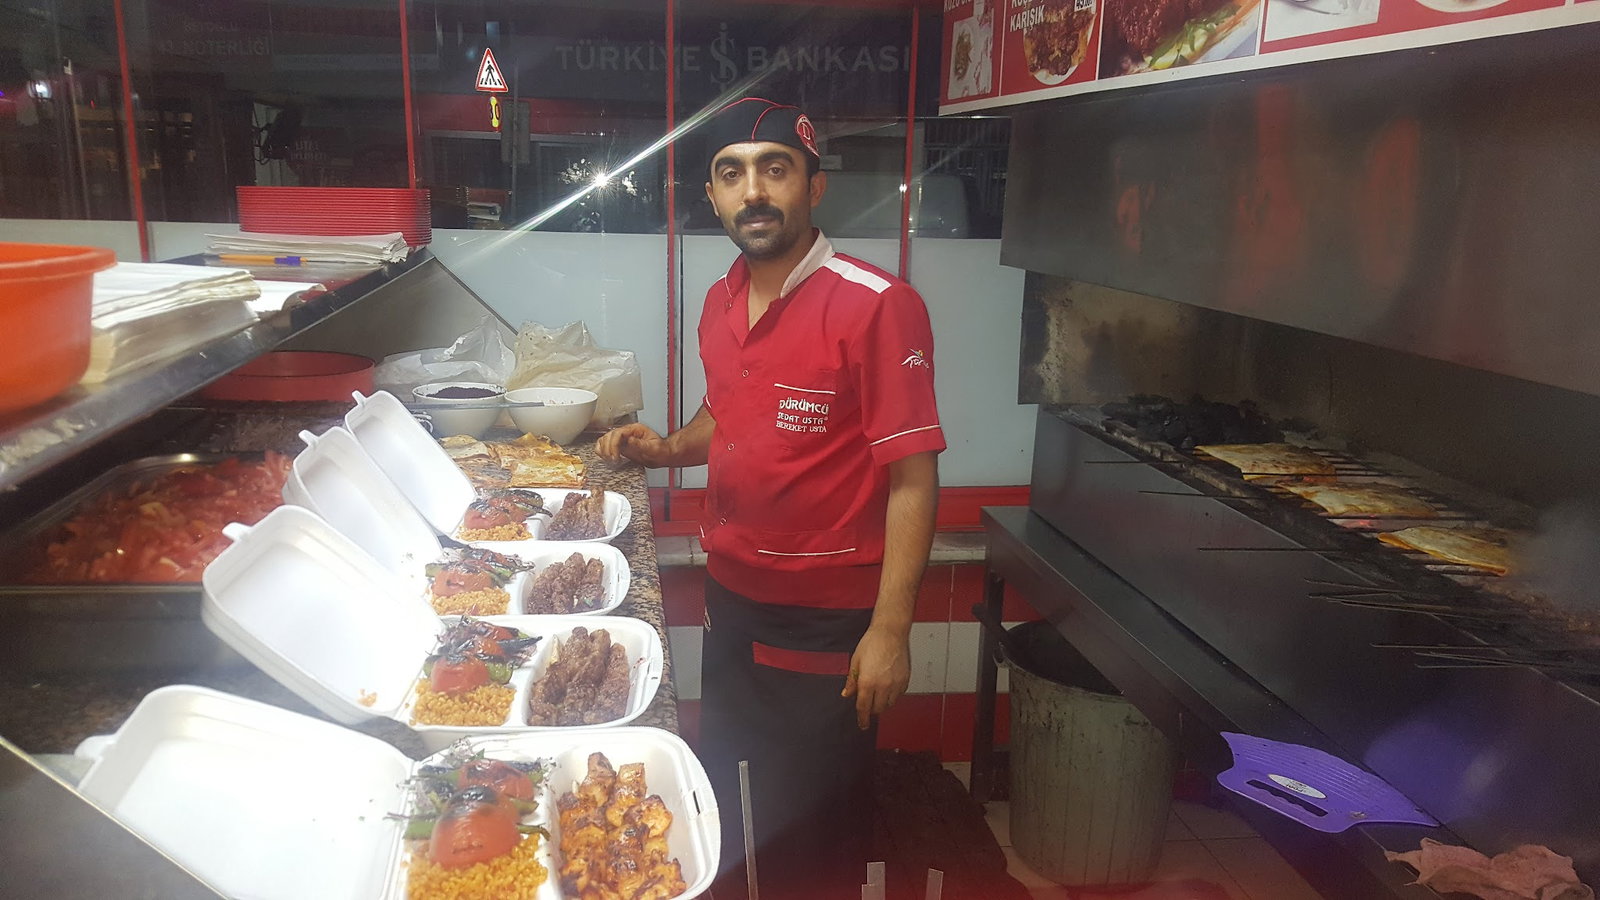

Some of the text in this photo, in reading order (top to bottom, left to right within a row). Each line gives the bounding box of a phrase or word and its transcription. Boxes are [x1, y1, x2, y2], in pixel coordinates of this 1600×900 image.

[1010, 4, 1045, 33] KARIŞIK
[747, 45, 911, 72] BANKASI
[779, 397, 829, 415] DÜRÜMCÜ
[776, 420, 807, 433] BEREKET
[777, 412, 800, 423] SEDAT
